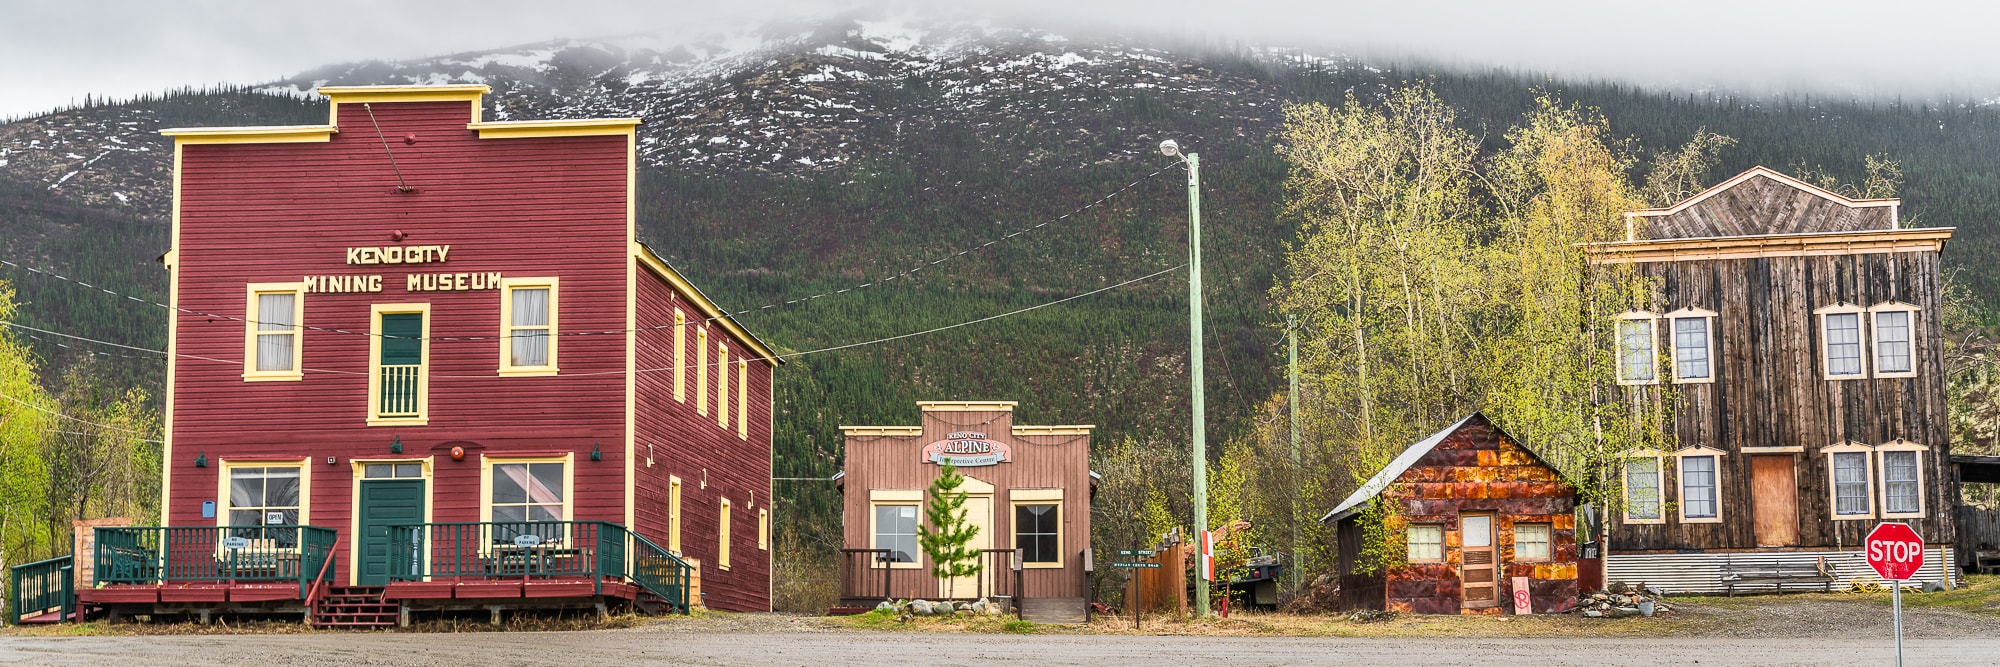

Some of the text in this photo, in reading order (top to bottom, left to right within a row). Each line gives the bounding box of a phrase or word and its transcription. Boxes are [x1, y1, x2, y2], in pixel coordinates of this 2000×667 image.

[347, 245, 450, 265] KENO CITY
[303, 272, 501, 293] MINING MUSEUM
[948, 432, 968, 440] KENO
[944, 440, 990, 454] ALPINE
[975, 456, 995, 464] Centre
[268, 513, 282, 521] OPEN
[1870, 540, 1921, 563] STOP
